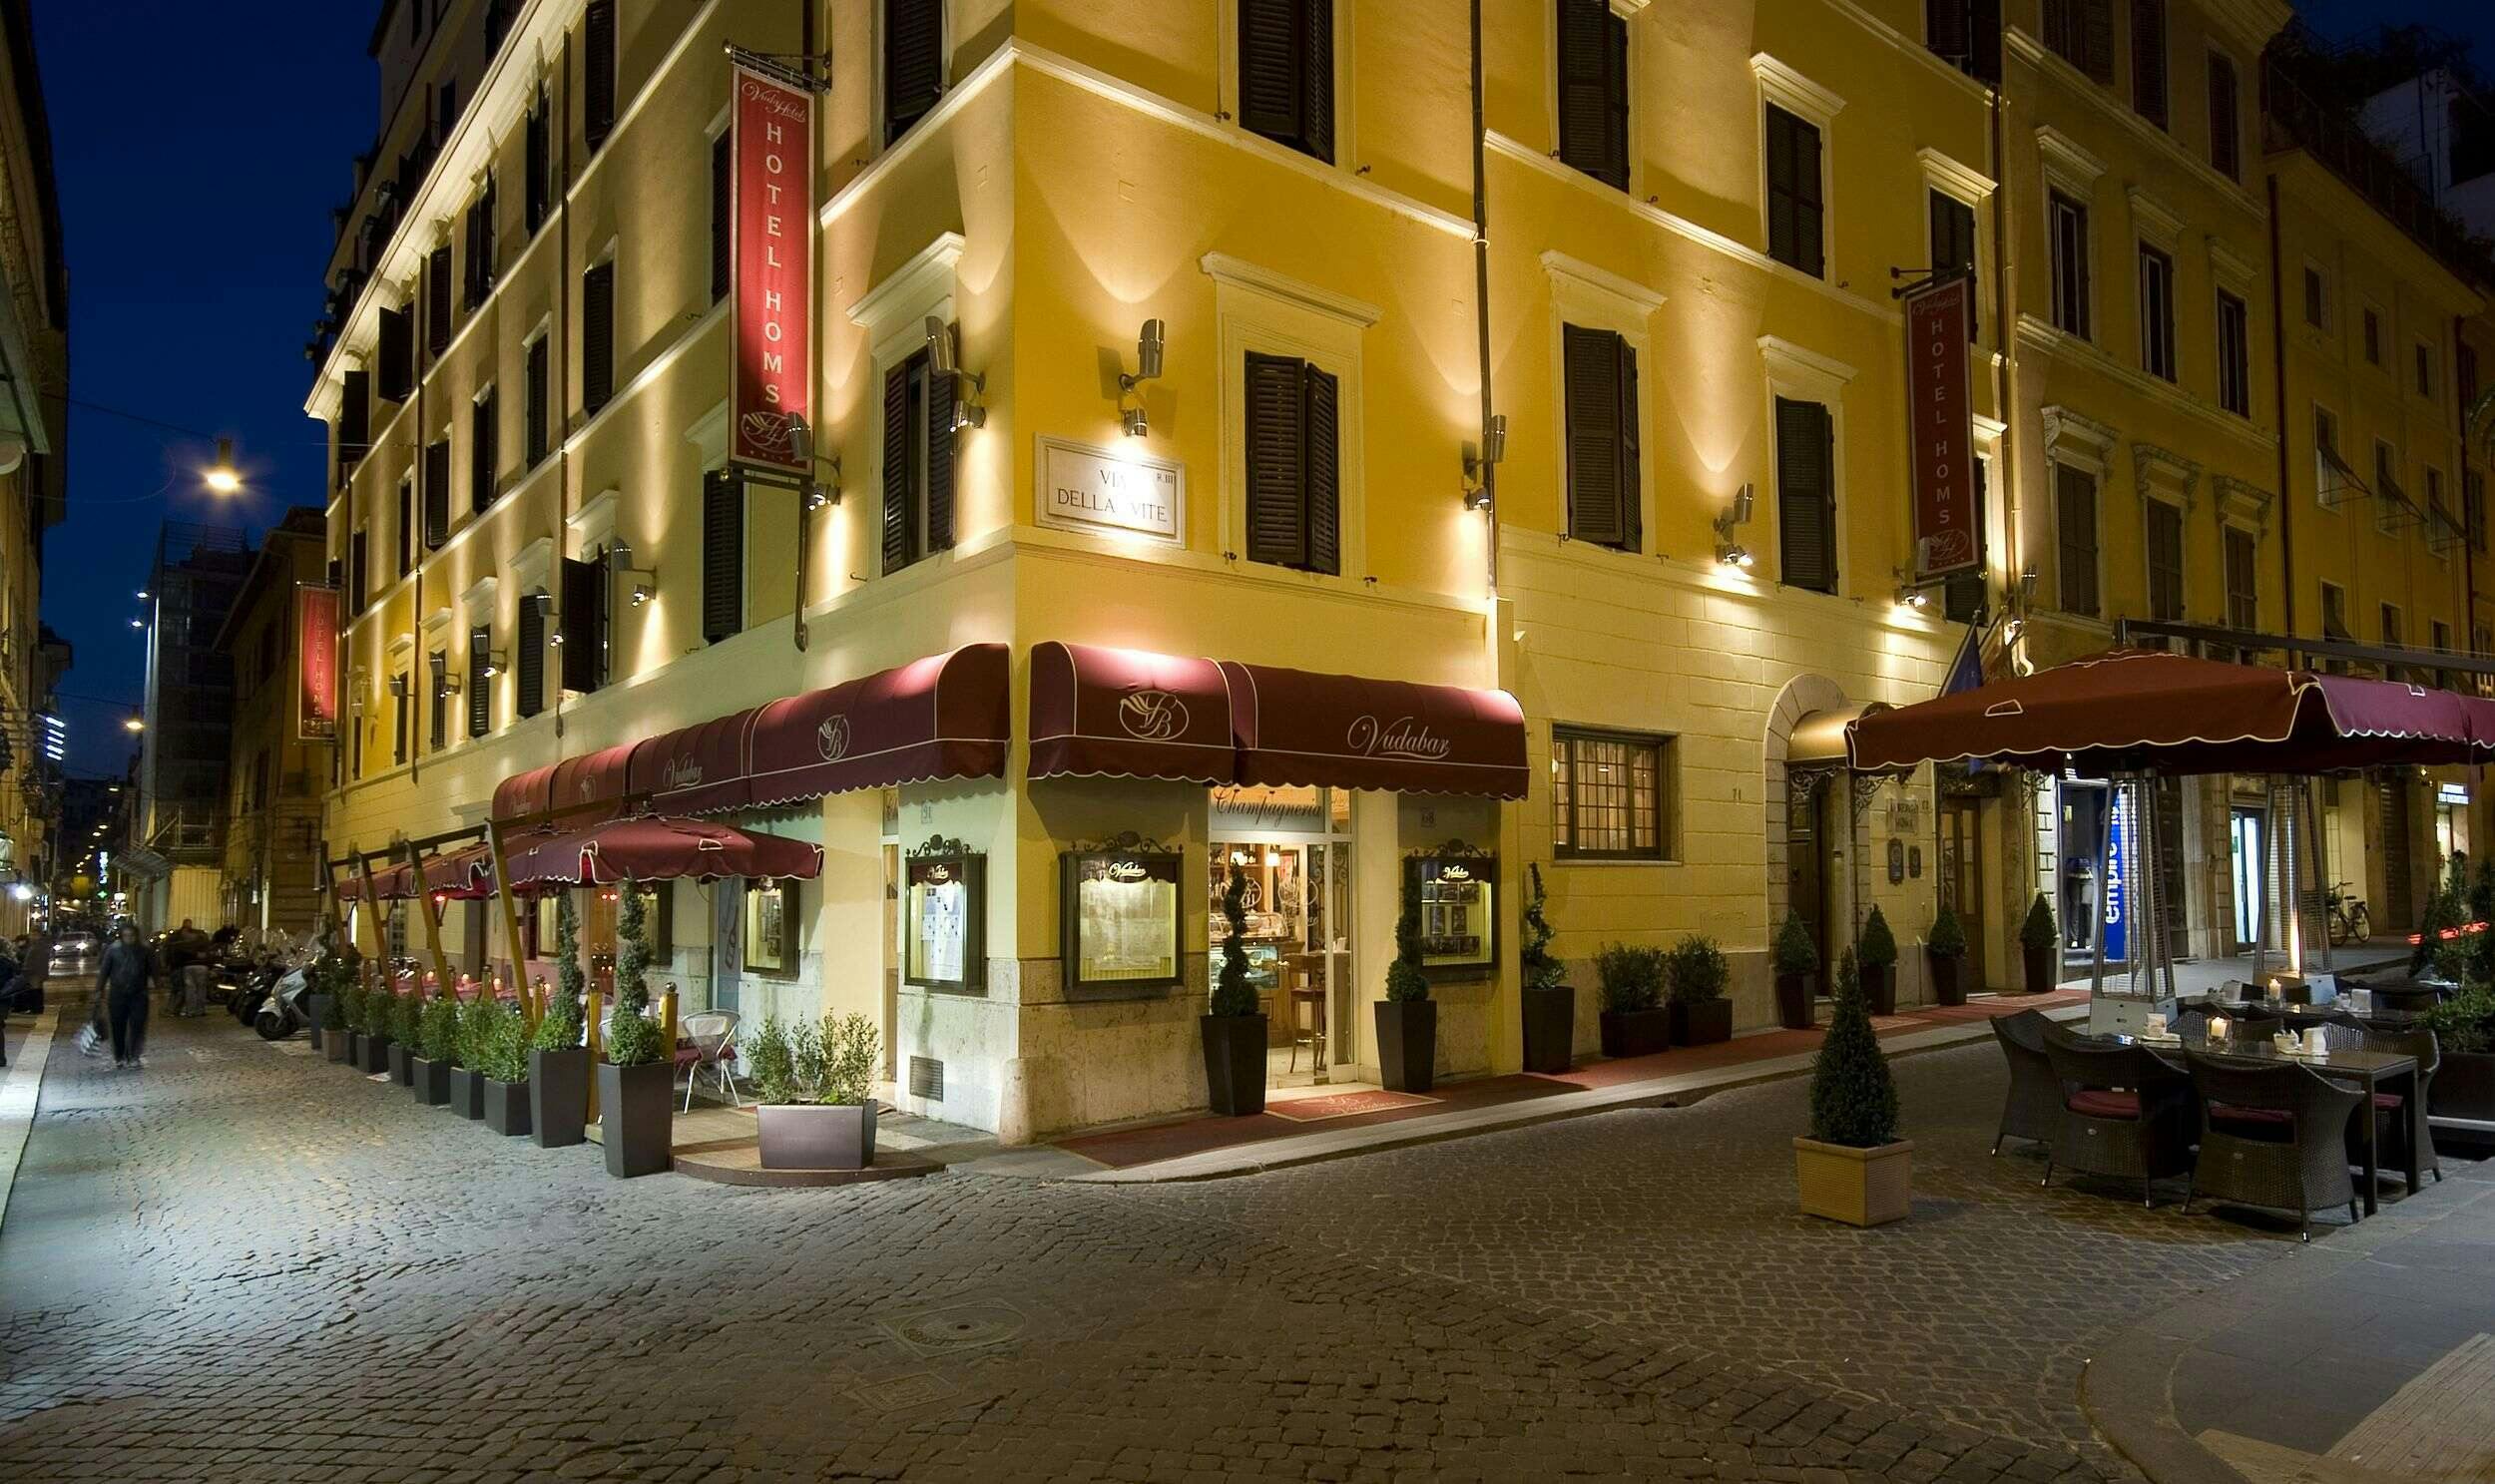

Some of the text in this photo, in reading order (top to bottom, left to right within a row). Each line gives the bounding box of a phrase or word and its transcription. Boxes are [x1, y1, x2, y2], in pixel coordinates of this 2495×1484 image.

[763, 122, 782, 403] HOTEL HOMS
[1931, 318, 1950, 525] HOTEL HOMS
[1058, 488, 1168, 522] DELLA VITE
[314, 671, 323, 715] HOMS
[1347, 715, 1450, 759] Vudabar
